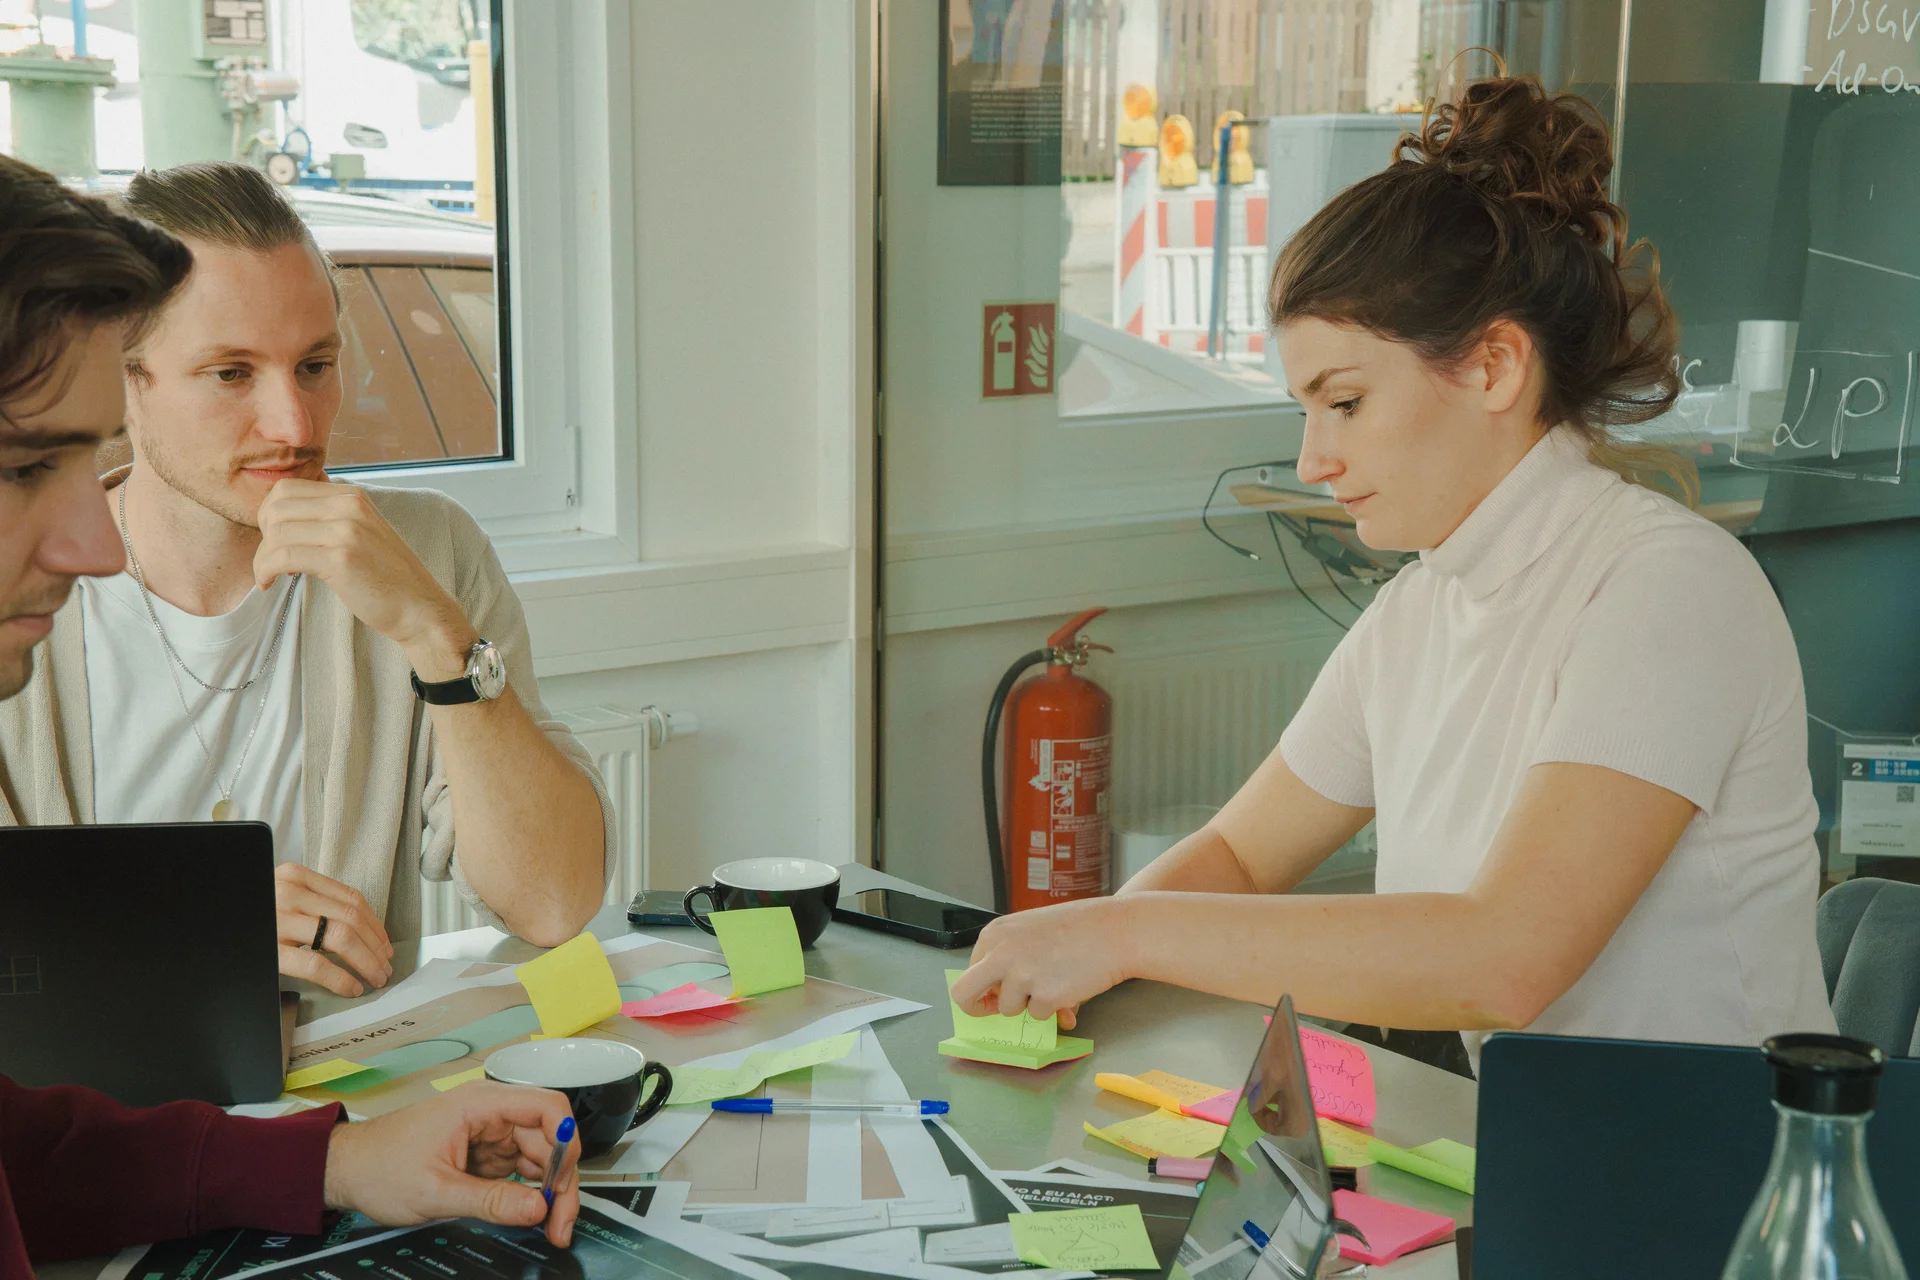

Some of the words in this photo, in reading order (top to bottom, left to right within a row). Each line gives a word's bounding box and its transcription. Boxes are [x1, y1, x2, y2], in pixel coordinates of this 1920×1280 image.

[1851, 761, 1864, 777] 2
[350, 1036, 366, 1044] &
[1045, 1189, 1065, 1198] EU
